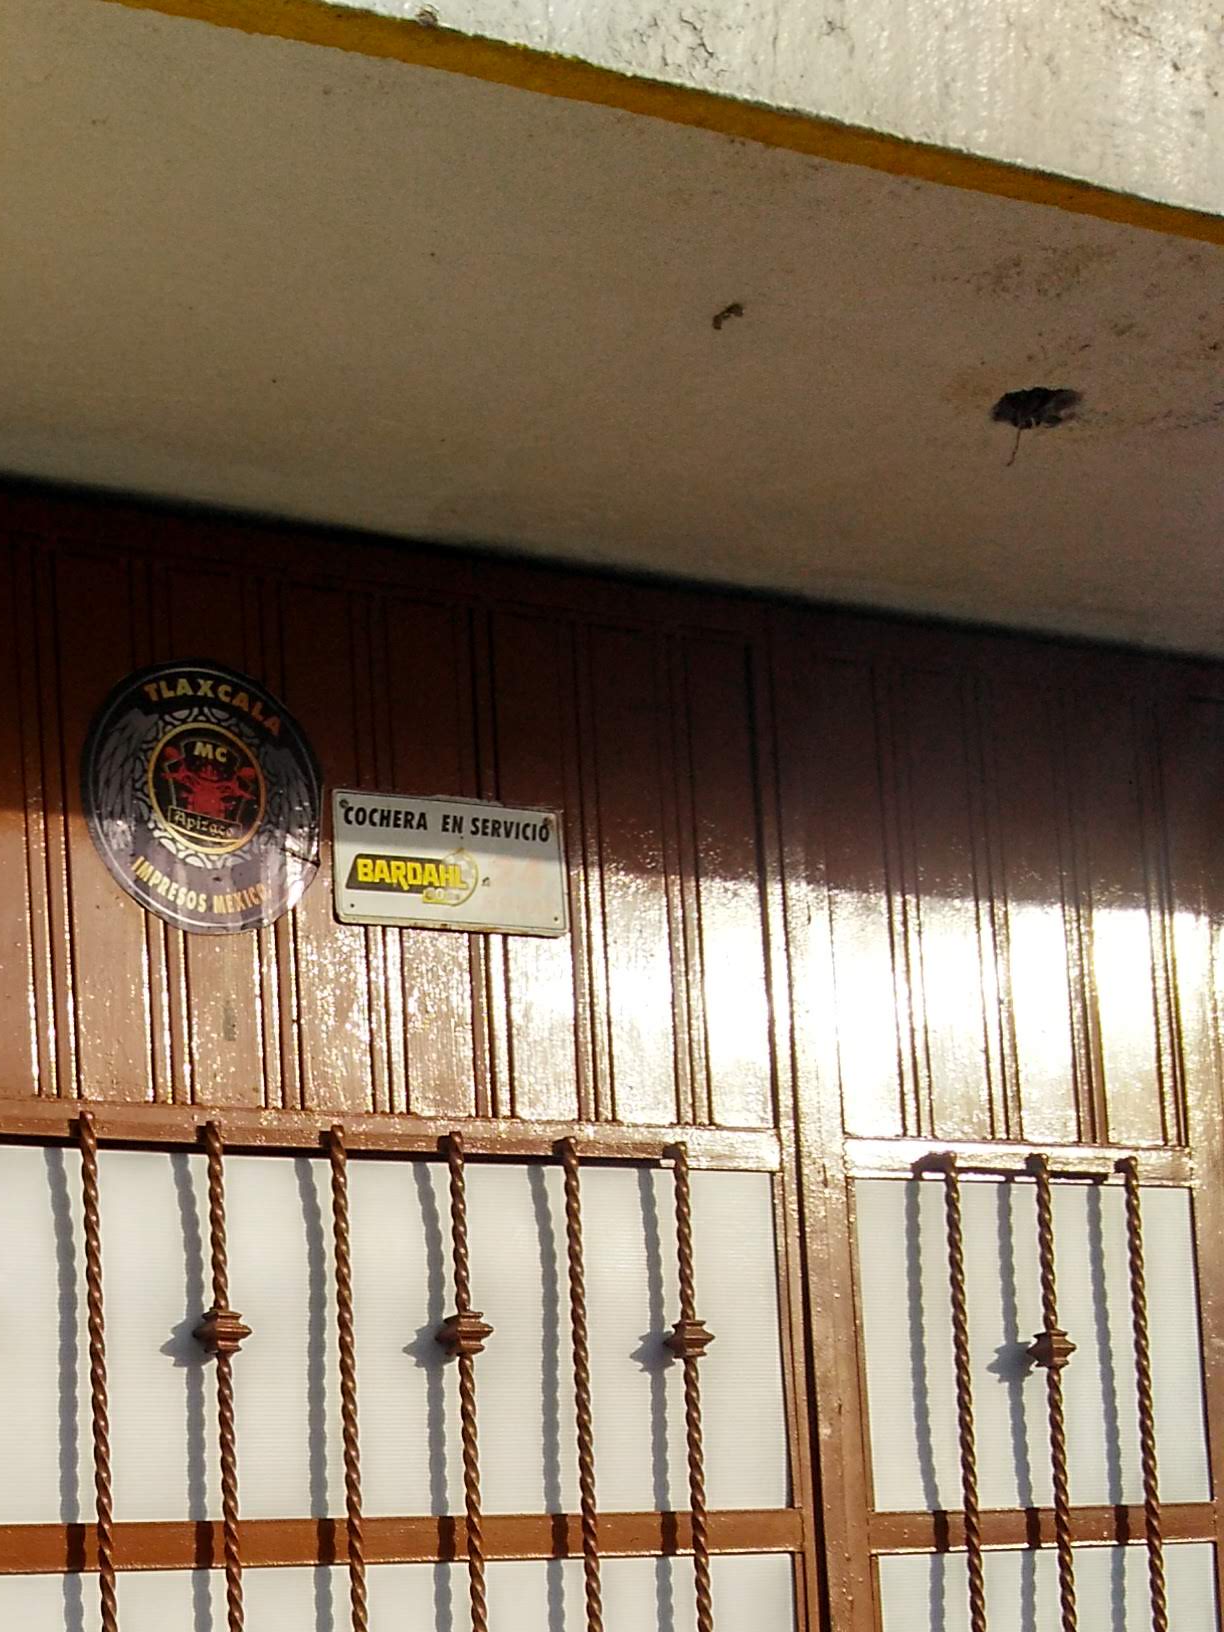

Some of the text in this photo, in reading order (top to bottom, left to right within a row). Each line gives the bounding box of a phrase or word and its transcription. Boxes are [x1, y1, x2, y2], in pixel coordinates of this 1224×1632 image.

[144, 678, 281, 737] TLAXCALA
[193, 742, 228, 763] MC
[173, 811, 234, 837] Apizaco
[343, 806, 428, 831] COCHERA
[441, 814, 464, 834] EN
[130, 855, 208, 913] IMPRESOS
[356, 857, 469, 891] BARDAHL
